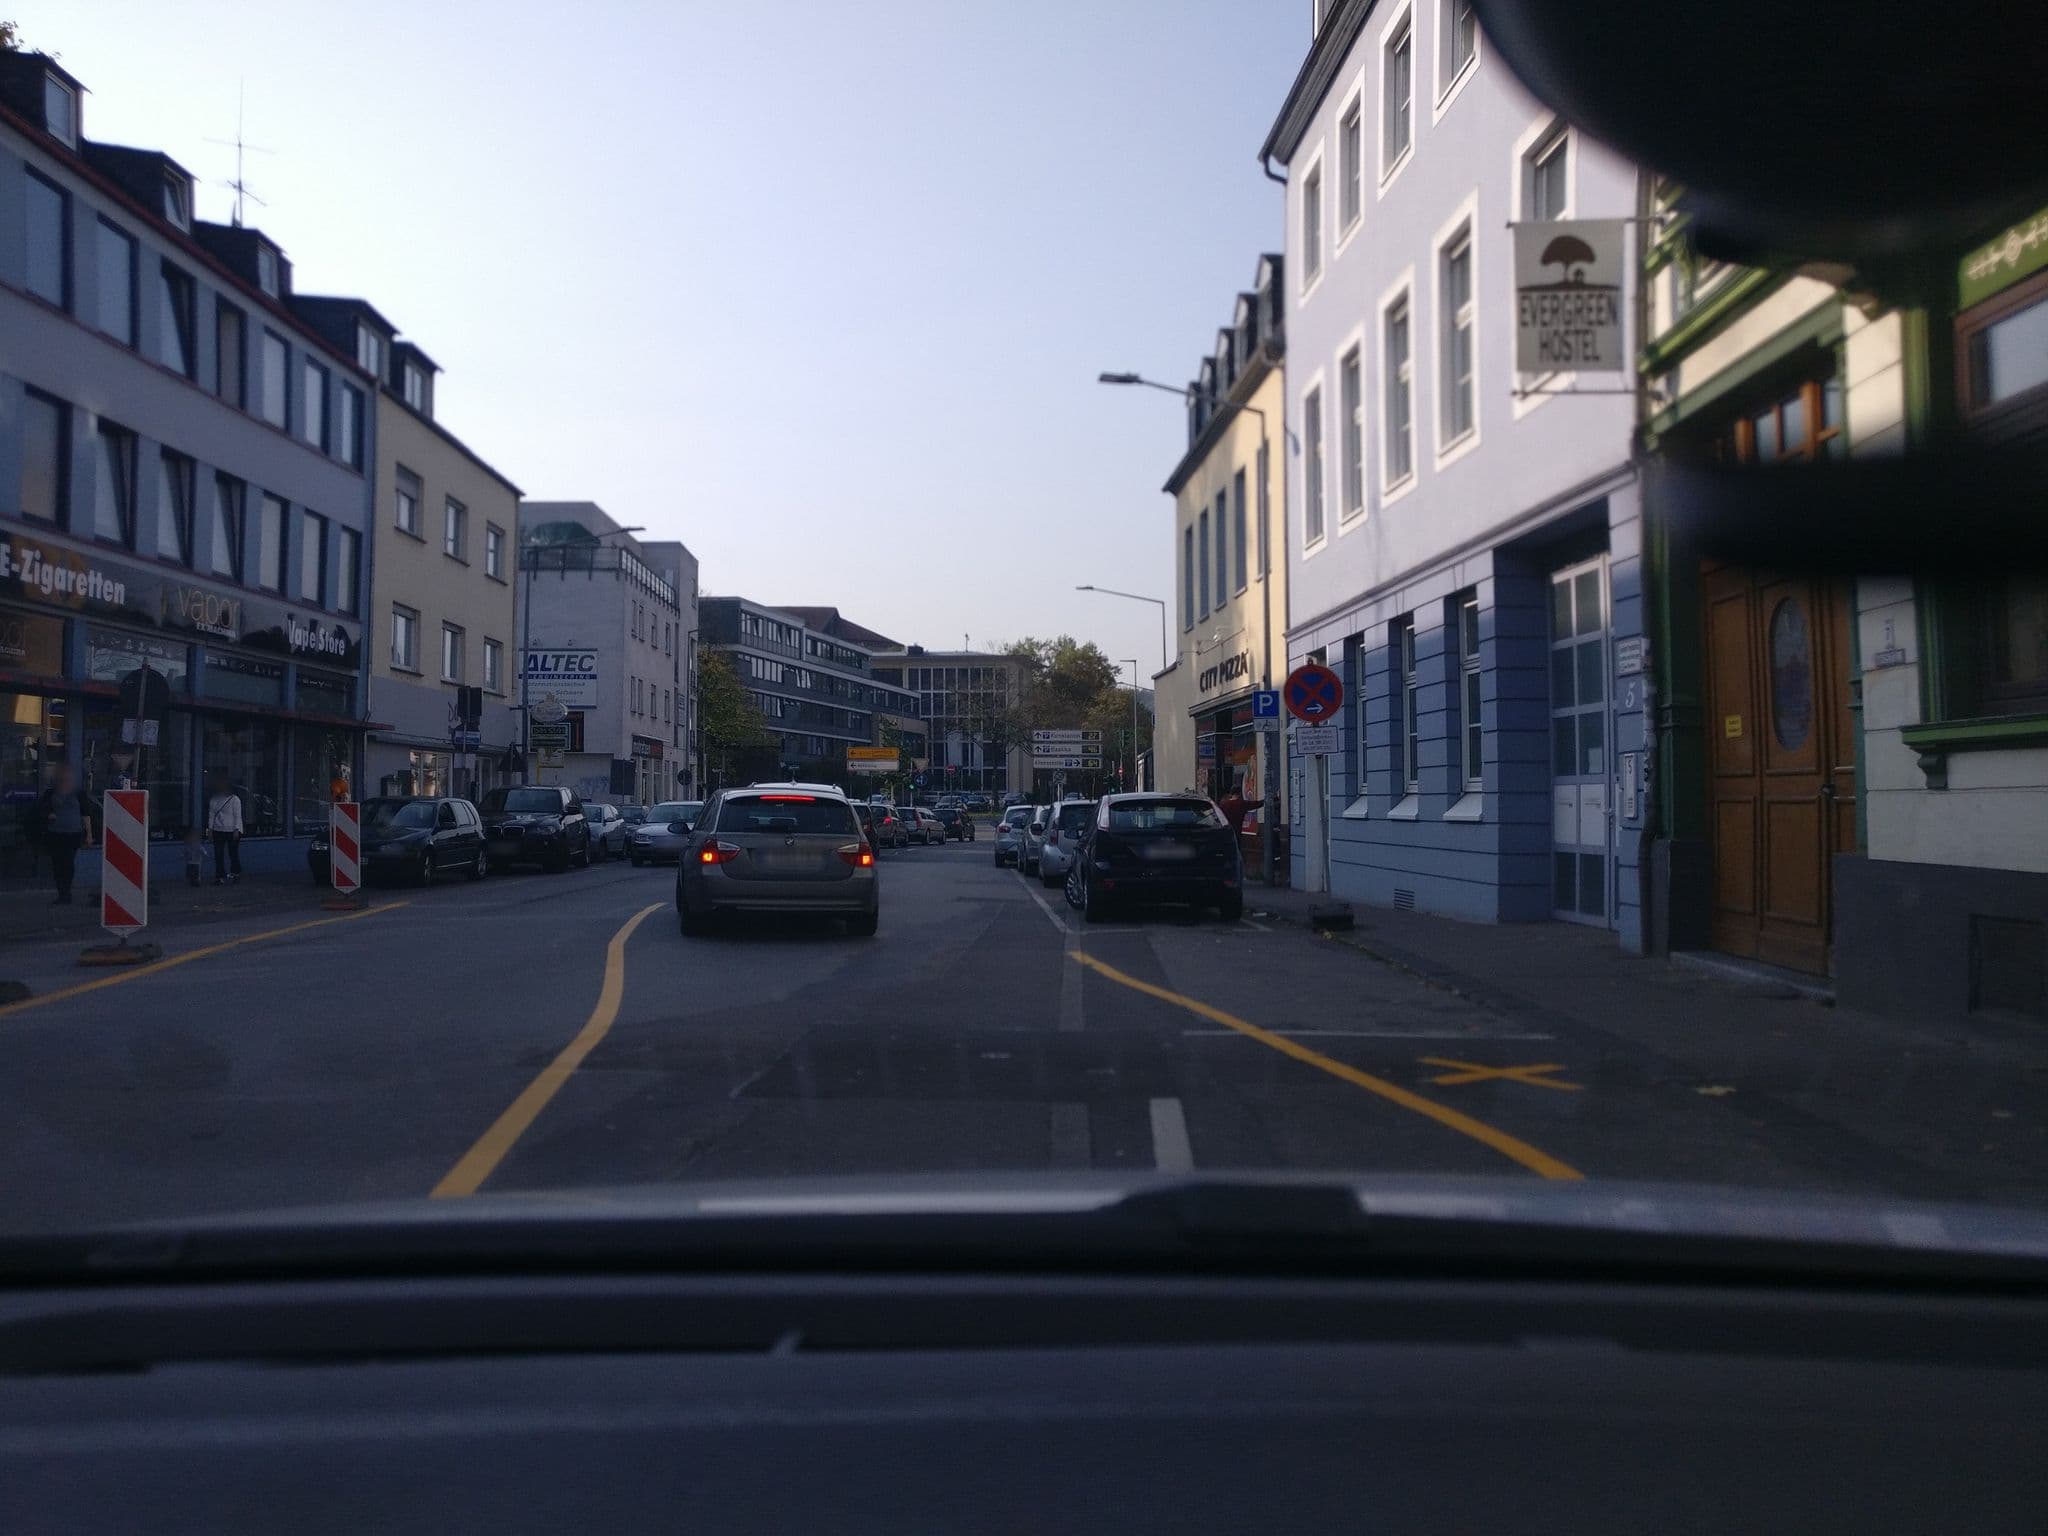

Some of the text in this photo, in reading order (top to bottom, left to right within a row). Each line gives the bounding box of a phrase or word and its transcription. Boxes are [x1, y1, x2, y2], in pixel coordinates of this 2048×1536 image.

[1520, 294, 1618, 327] EVERGREEN
[1539, 330, 1601, 362] HOSTEL
[0, 543, 125, 605] E-Zigaretten
[287, 618, 345, 656] Vape Store
[528, 654, 594, 672] ALTEC
[1200, 652, 1249, 692] CITY PIZZA
[1259, 694, 1273, 714] P
[1625, 682, 1636, 708] 5
